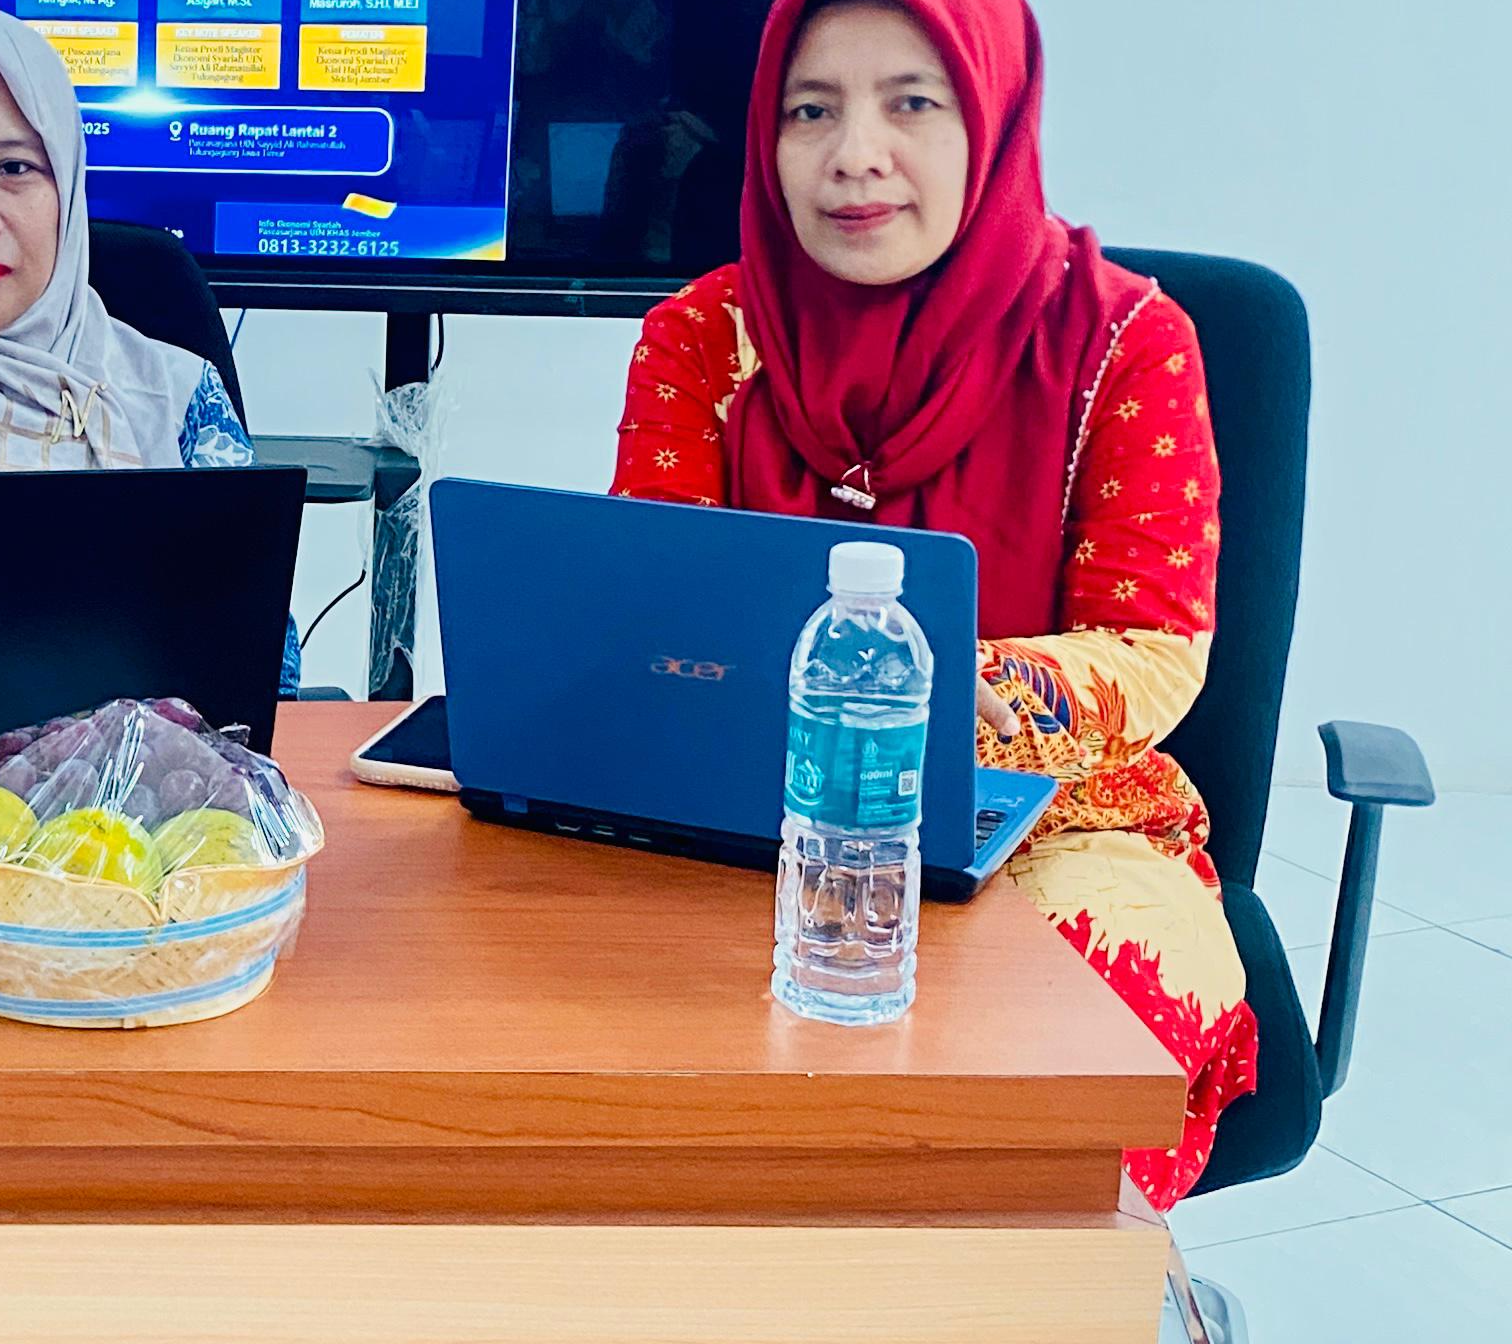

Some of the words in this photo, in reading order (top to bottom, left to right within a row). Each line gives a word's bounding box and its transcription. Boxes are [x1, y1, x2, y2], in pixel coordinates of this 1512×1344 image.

[189, 123, 235, 140] Ruang
[238, 124, 279, 140] Rapat
[282, 125, 325, 138] Lantai
[328, 125, 337, 138] 2
[258, 220, 274, 228] Info
[327, 229, 350, 237] KHAS
[258, 238, 400, 256] 0813-3232-6125
[650, 656, 737, 682] acer
